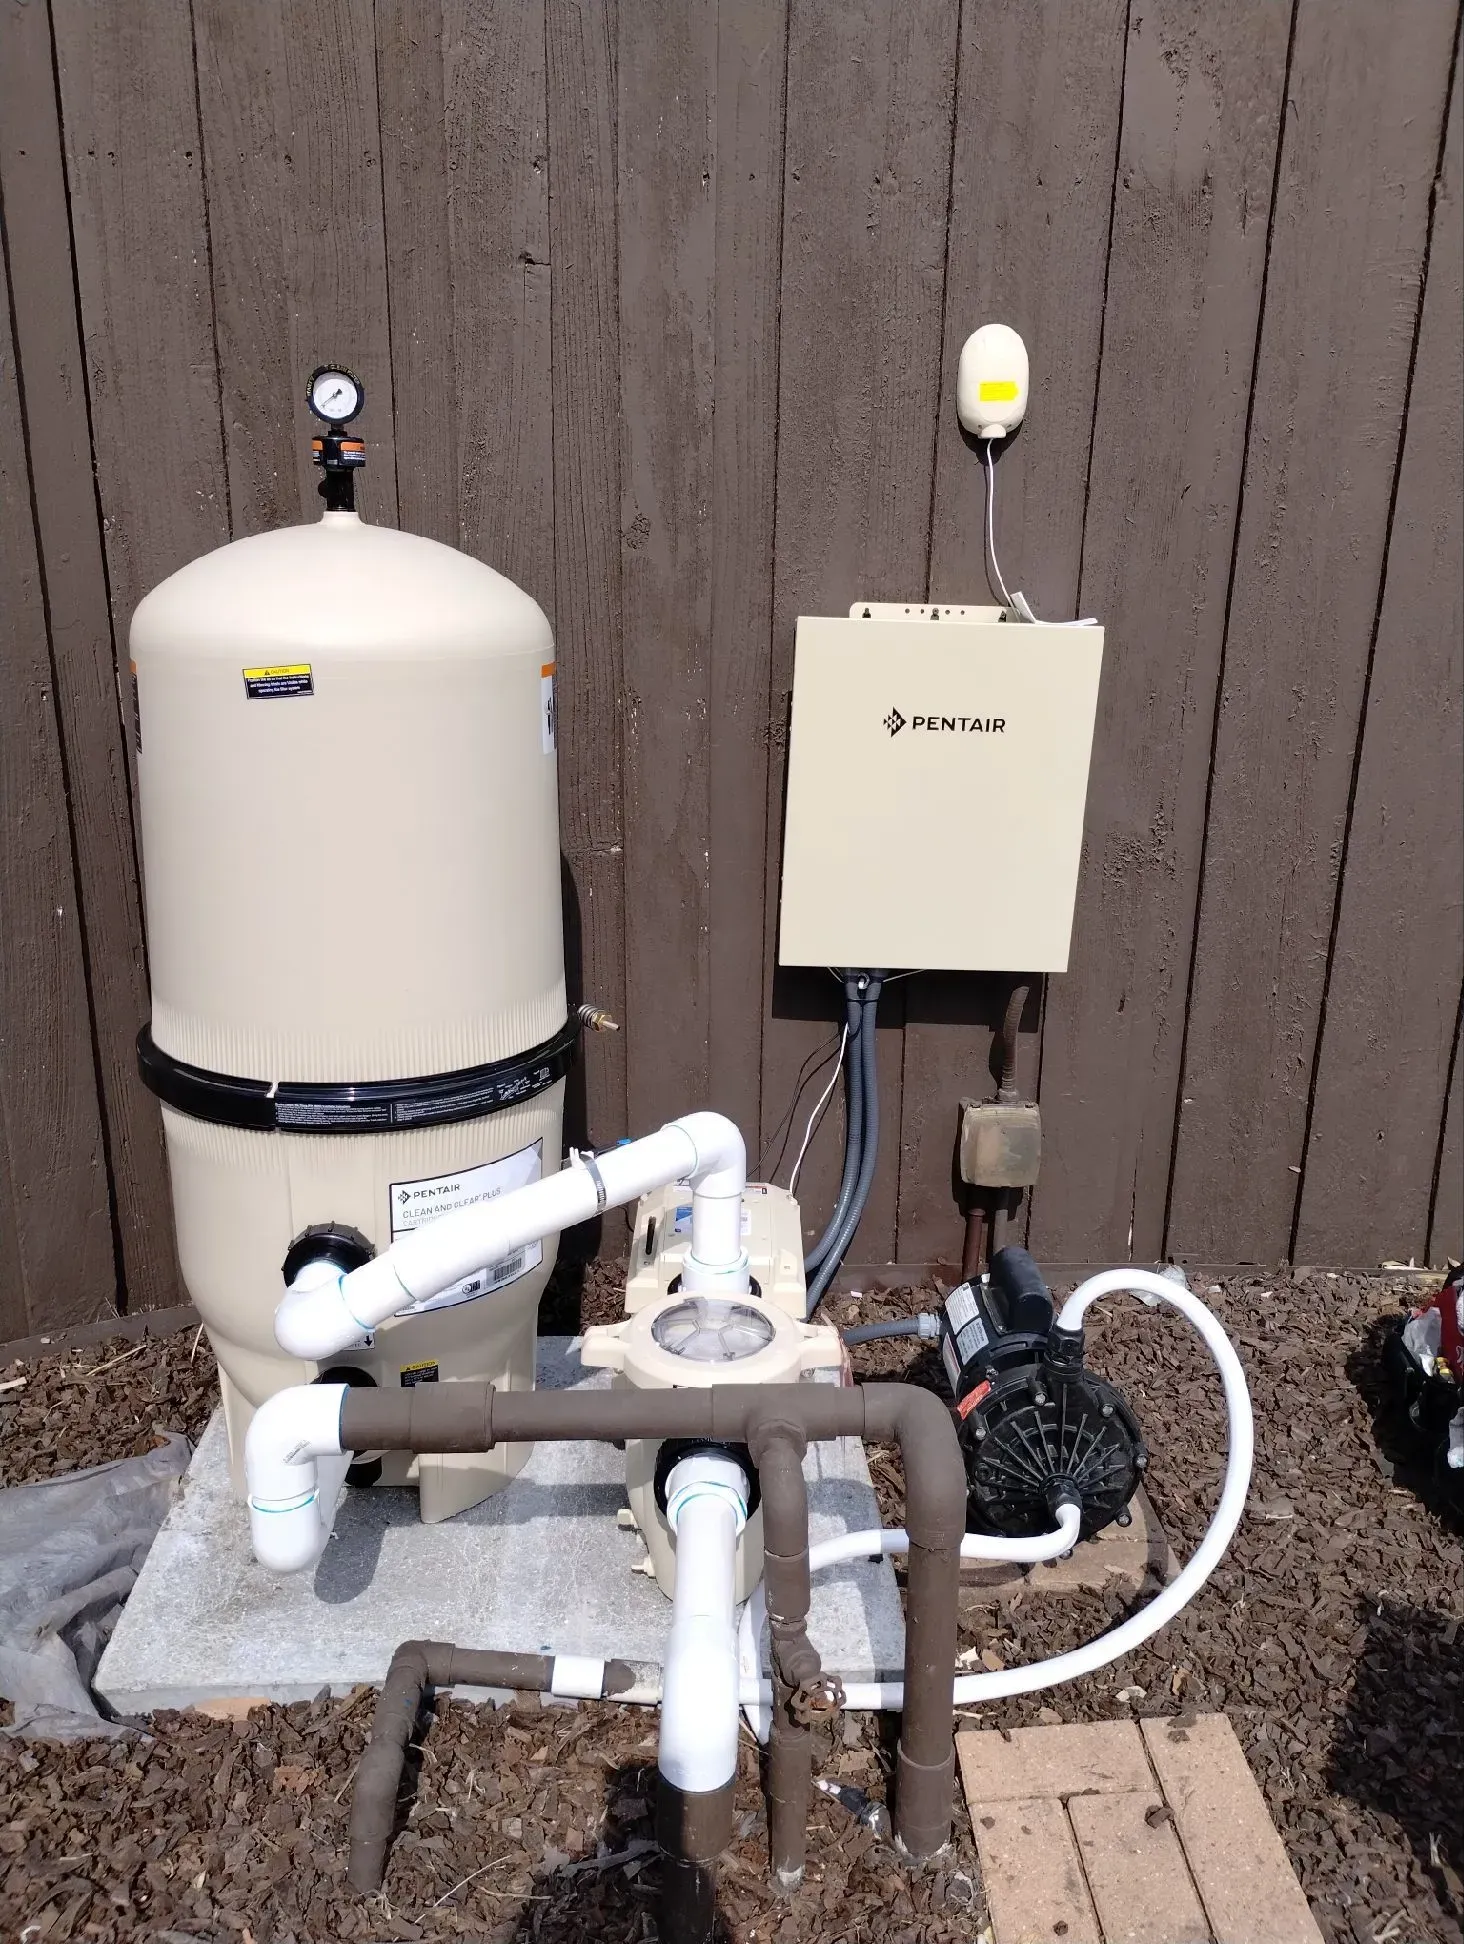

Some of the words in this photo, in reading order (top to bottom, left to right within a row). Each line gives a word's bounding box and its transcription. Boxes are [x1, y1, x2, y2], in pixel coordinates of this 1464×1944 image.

[912, 716, 1006, 733] PENTAIR
[413, 1184, 461, 1200] PENTAIR
[402, 1207, 433, 1219] CLEAN
[434, 1203, 453, 1213] AND
[482, 1187, 502, 1201] PLUS
